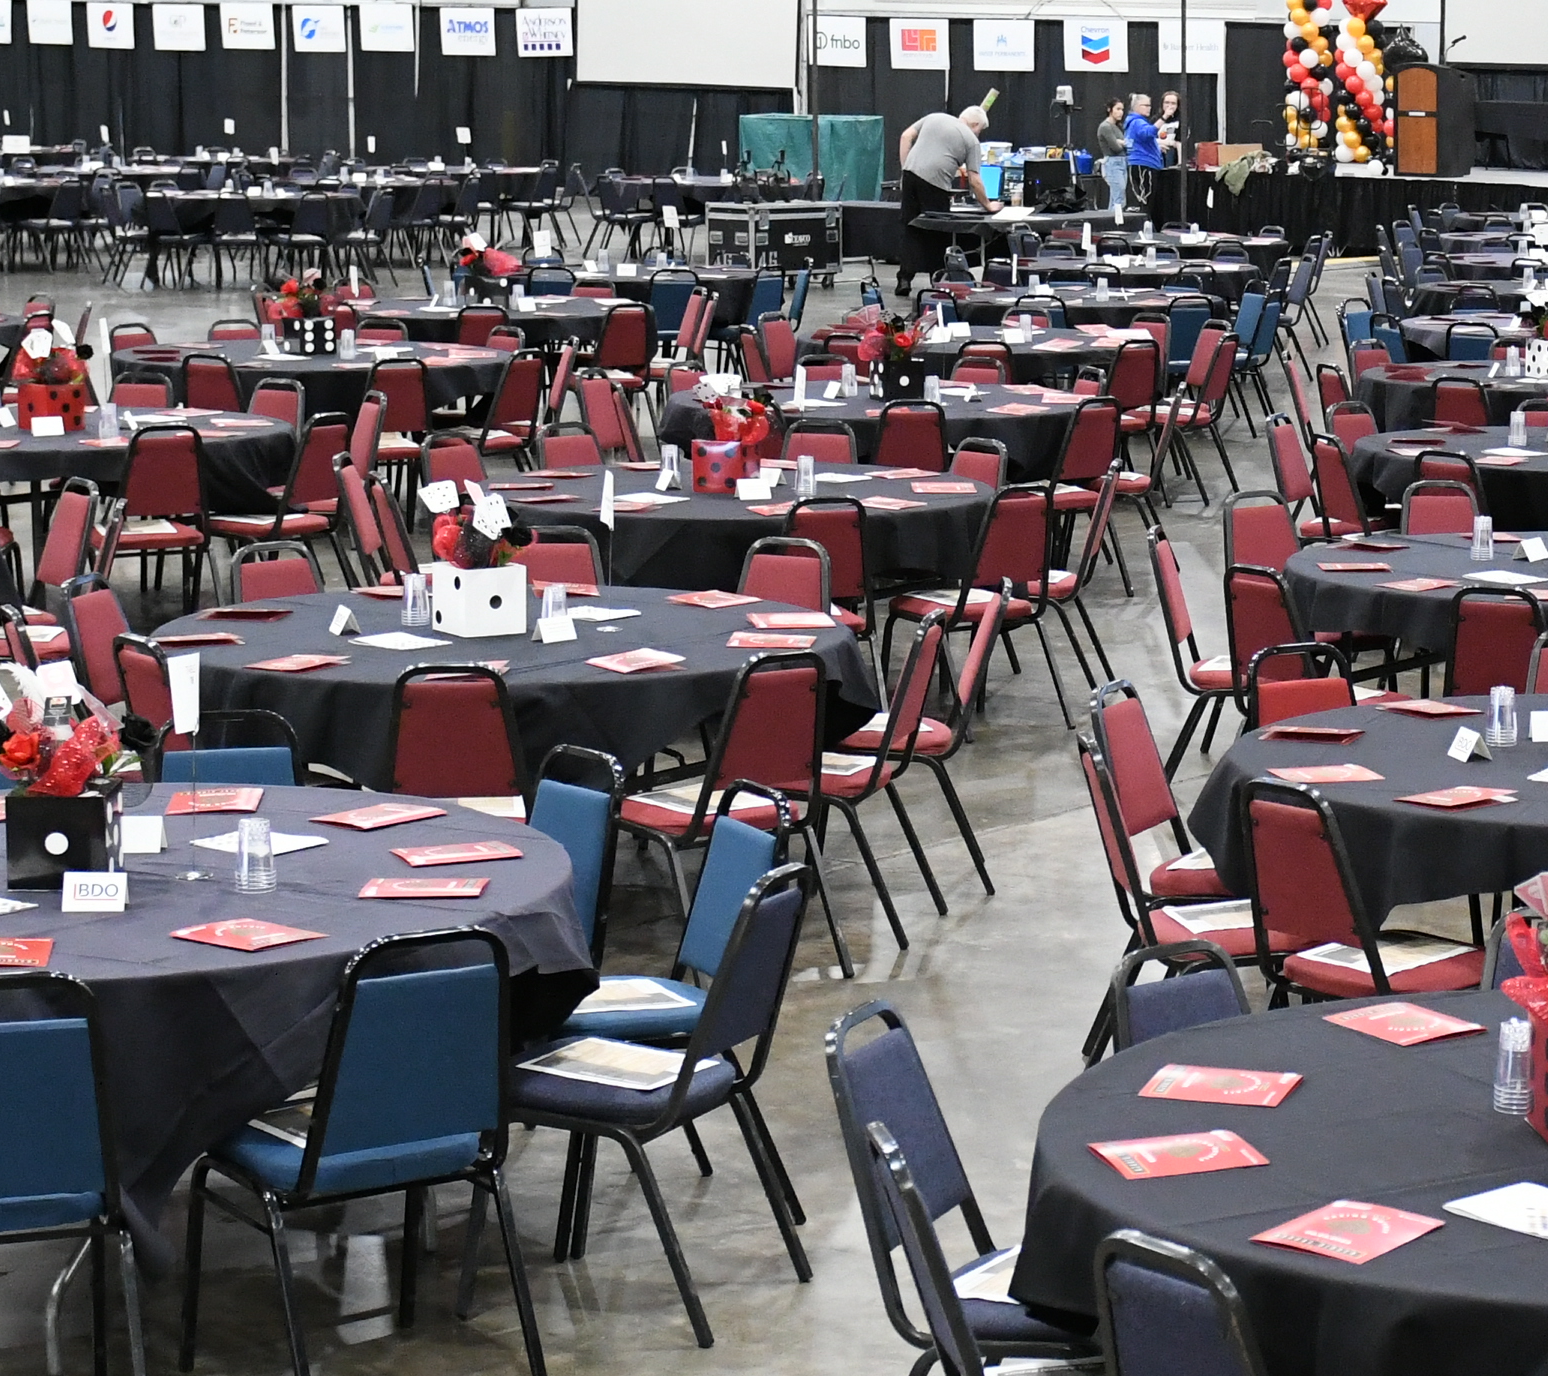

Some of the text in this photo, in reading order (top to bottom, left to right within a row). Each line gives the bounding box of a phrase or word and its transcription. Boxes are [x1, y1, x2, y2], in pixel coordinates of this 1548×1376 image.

[447, 19, 489, 34] ATMOS
[1080, 26, 1110, 34] Chevron
[457, 33, 489, 45] energy
[831, 34, 861, 50] fnbo
[79, 884, 119, 898] BDO
